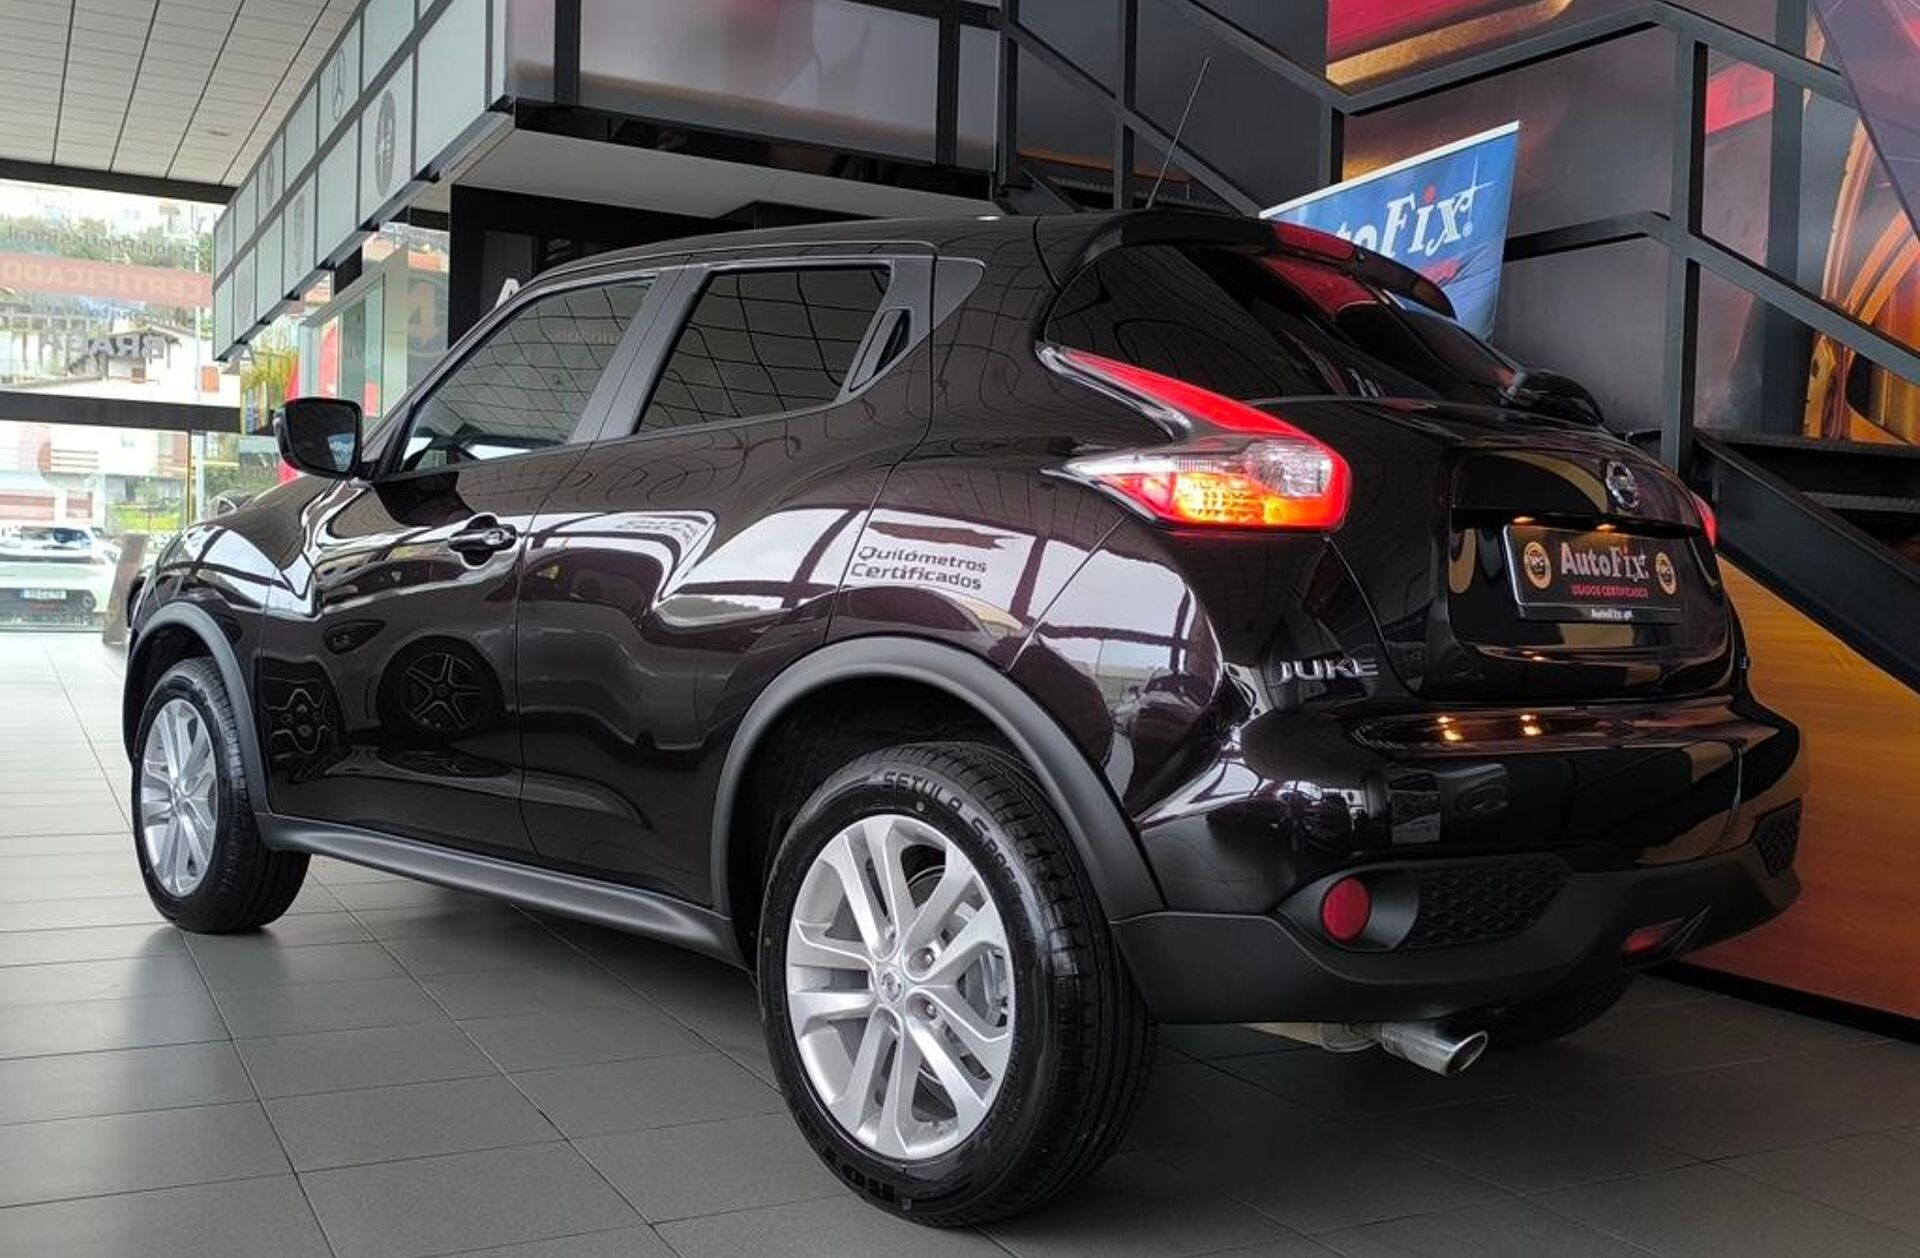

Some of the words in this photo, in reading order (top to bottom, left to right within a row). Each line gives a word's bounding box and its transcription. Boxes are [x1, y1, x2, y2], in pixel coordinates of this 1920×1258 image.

[858, 546, 987, 574] Quilómetros
[850, 563, 982, 590] Certificados
[1266, 659, 1378, 687] JUKE
